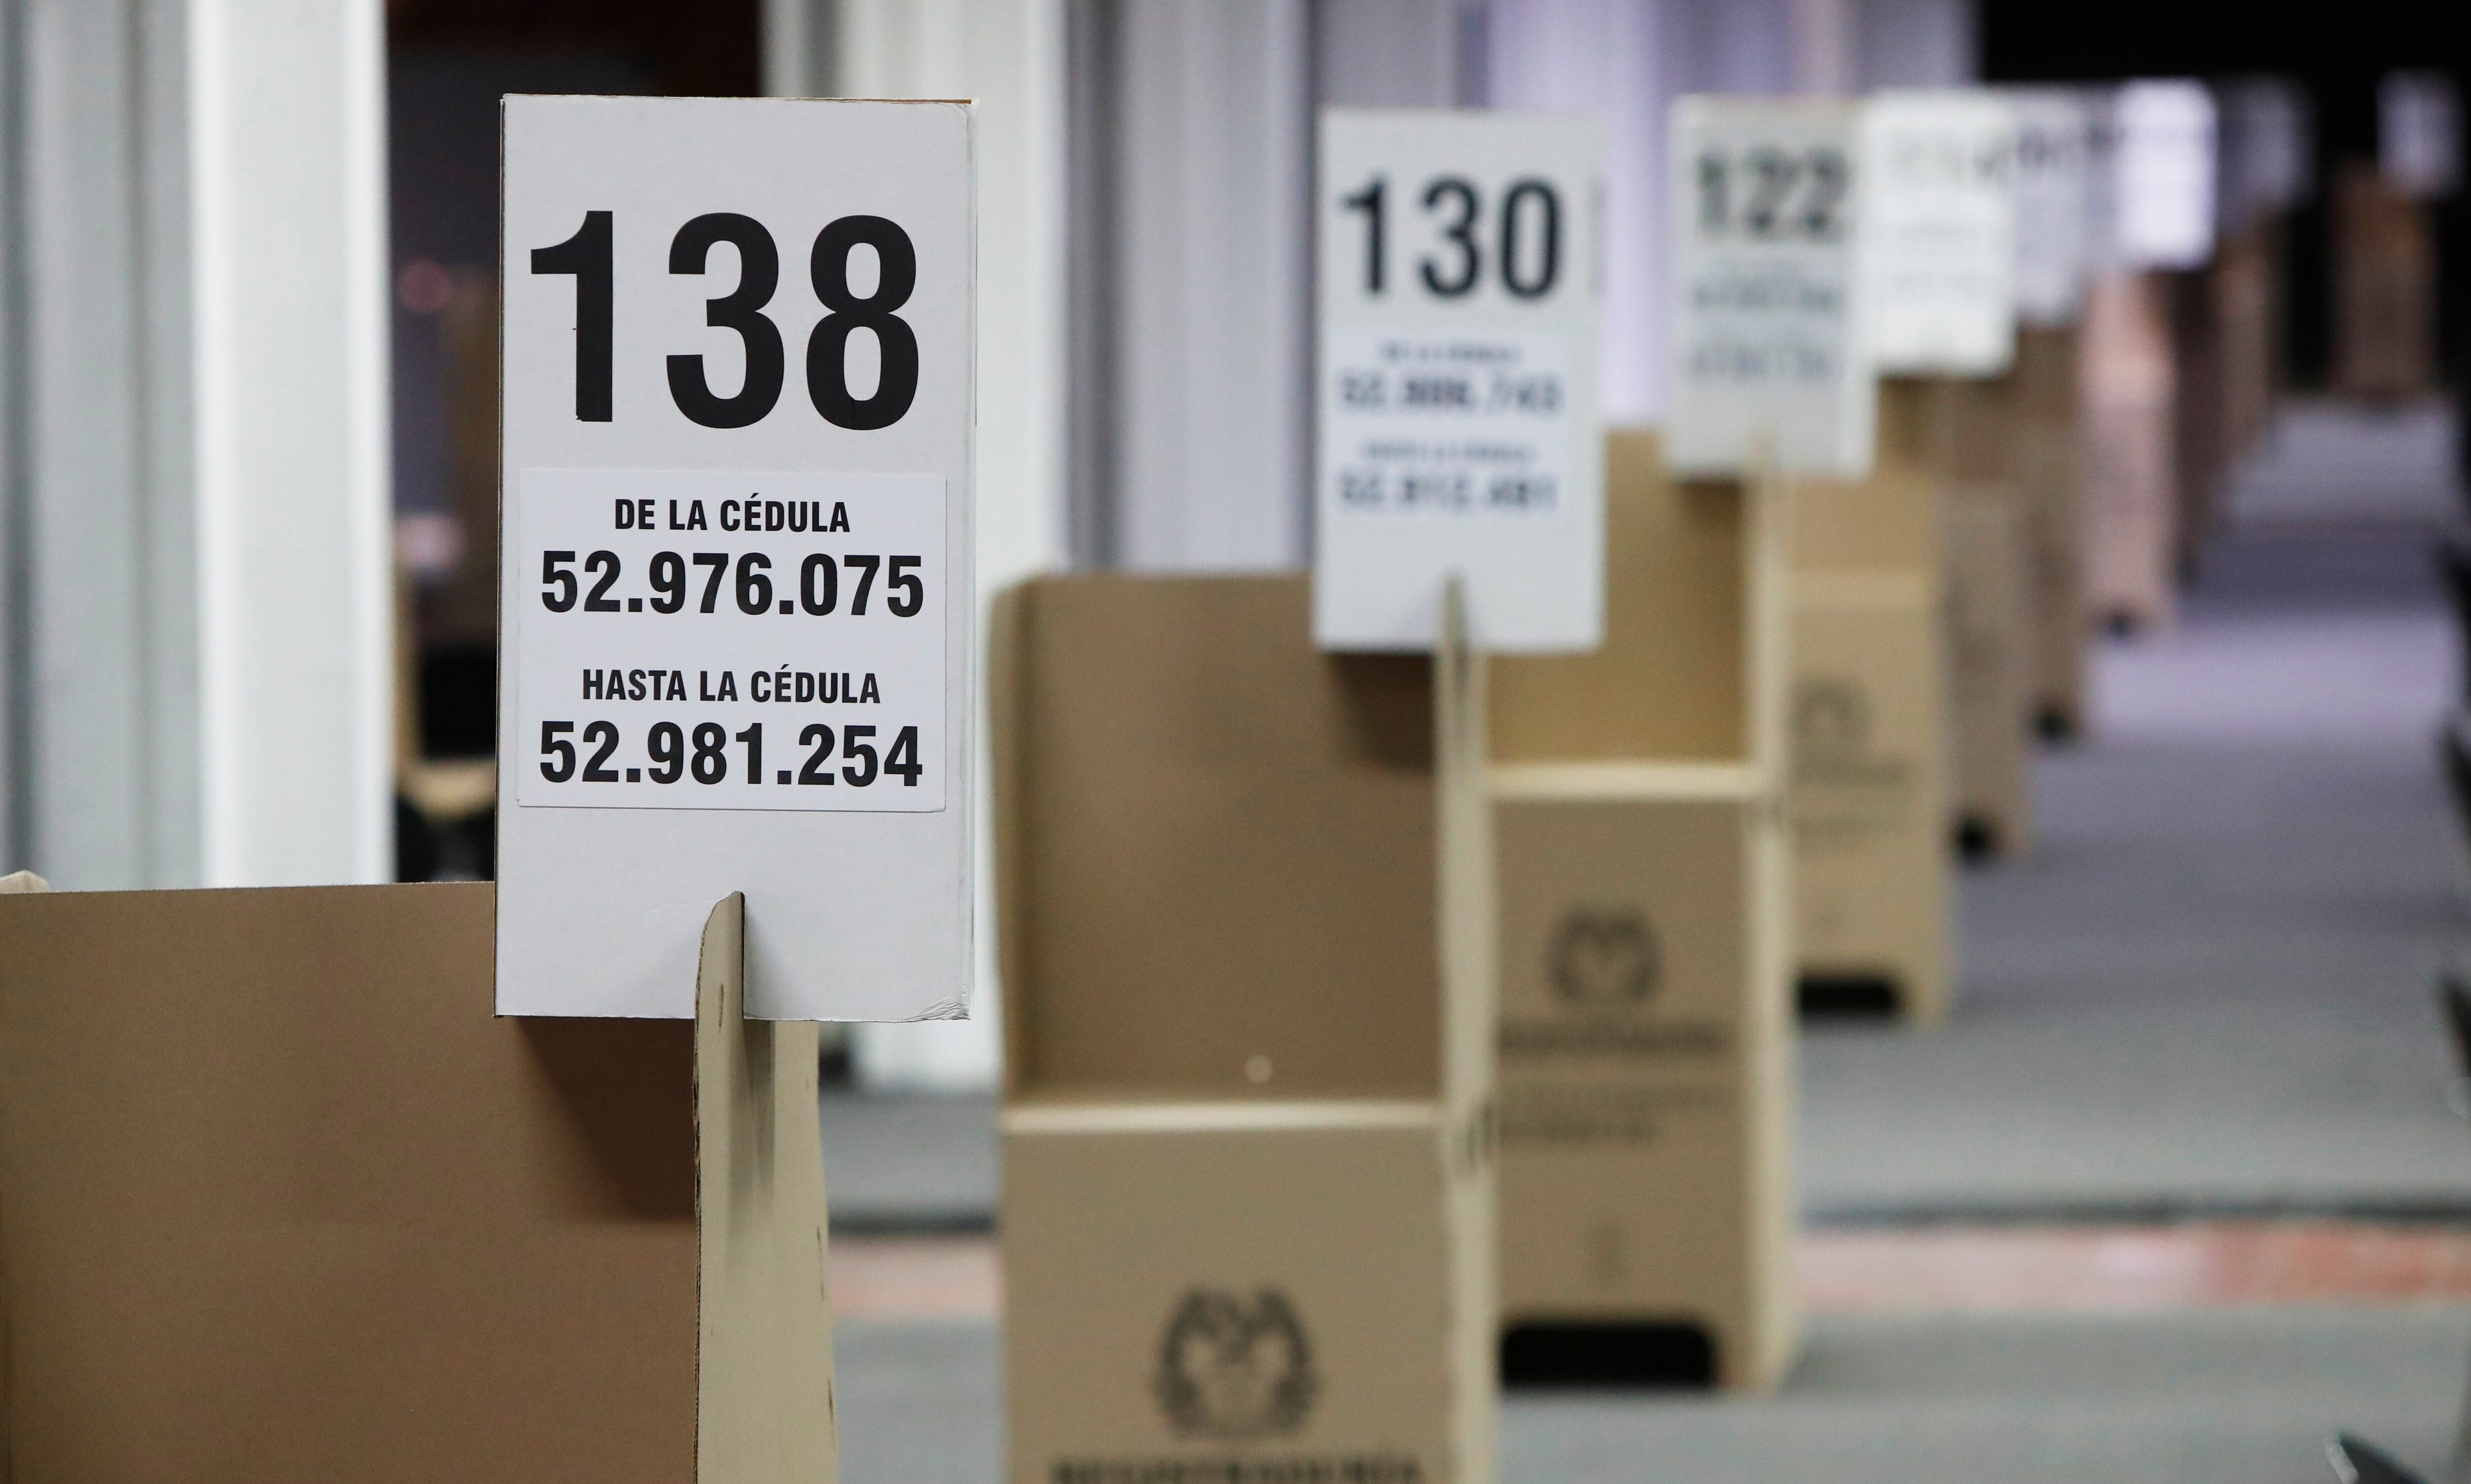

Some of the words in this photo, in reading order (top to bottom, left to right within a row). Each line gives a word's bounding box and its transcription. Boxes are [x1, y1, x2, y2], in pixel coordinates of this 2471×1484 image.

[1694, 147, 1847, 240] 122
[1344, 176, 1563, 301] 130
[530, 211, 919, 431] 138
[615, 499, 655, 530] DE
[669, 500, 708, 531] LA
[720, 492, 851, 533] CÉDULA
[542, 550, 924, 618] 52.976.075
[583, 669, 687, 701] HASTA
[700, 671, 738, 702] LA
[751, 663, 881, 704] CÉDULA
[540, 721, 923, 787] 52.981.254
